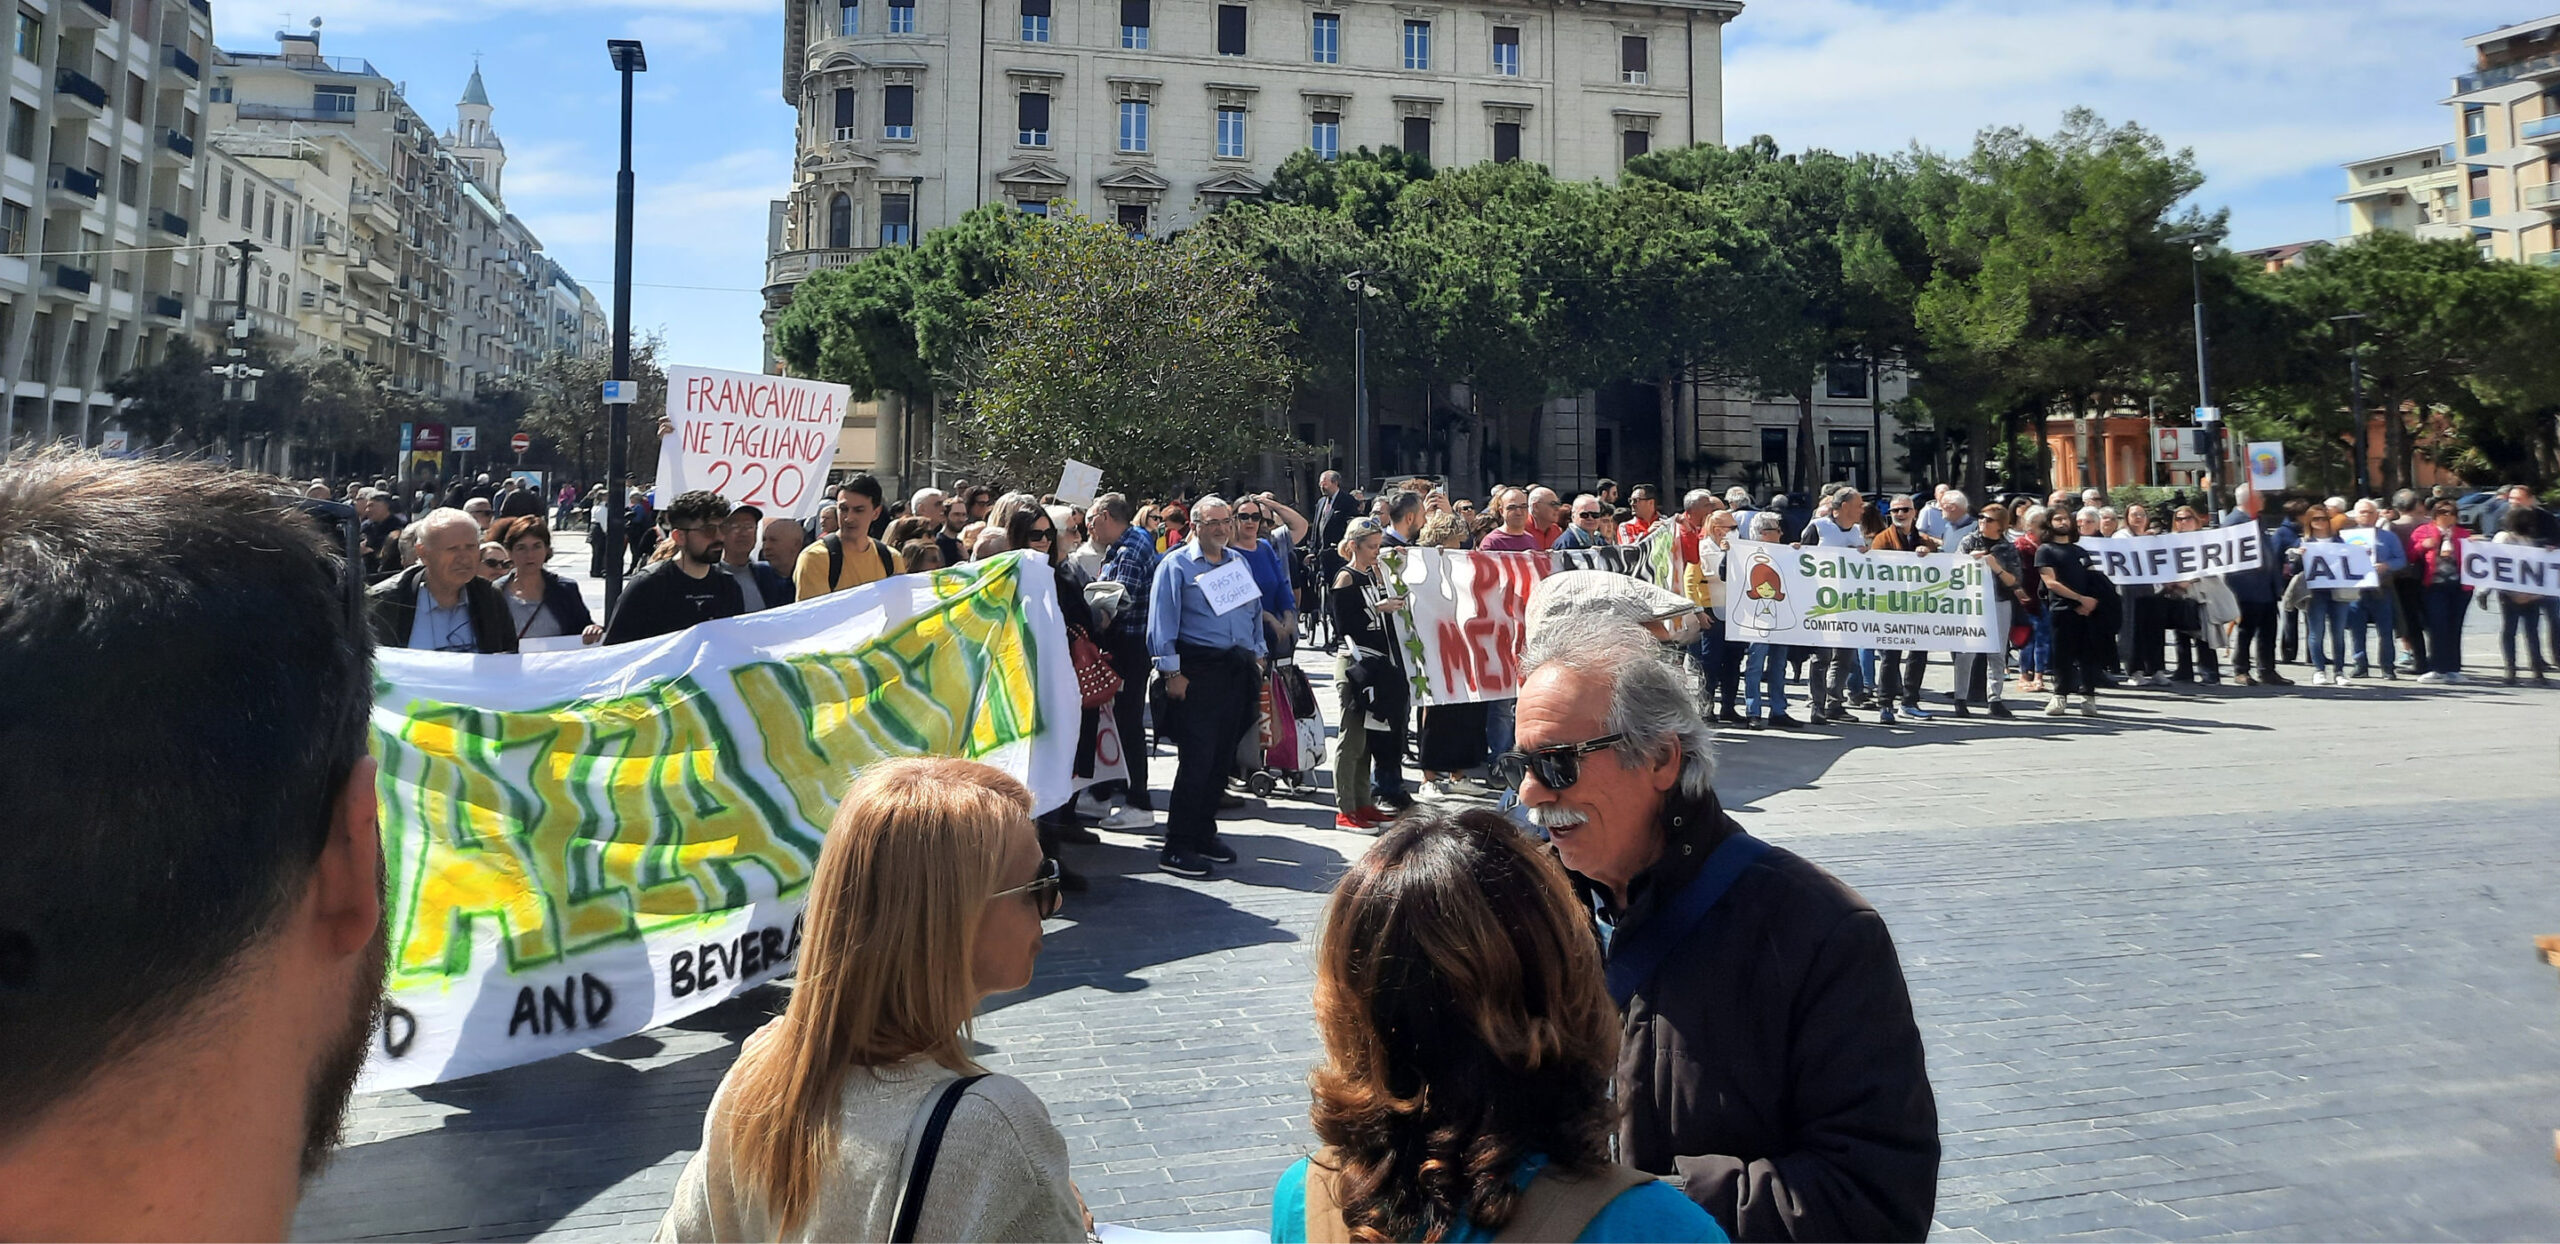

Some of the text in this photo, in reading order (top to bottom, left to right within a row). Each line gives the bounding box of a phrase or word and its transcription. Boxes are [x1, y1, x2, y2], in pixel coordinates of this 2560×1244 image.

[687, 376, 842, 425] FRANCAVILLA:
[682, 420, 825, 464] NE TAGLIANO
[707, 460, 805, 509] 220
[1209, 571, 1244, 591] BASTA
[1799, 553, 1983, 591] Salviamo gli
[2306, 555, 2365, 582] AL
[1815, 586, 1984, 616] Orti Urbani
[1803, 617, 1987, 638] COMITATO VIA SANTINA CAMPANA
[1876, 636, 1916, 646] PESCARA
[508, 972, 613, 1037] AND
